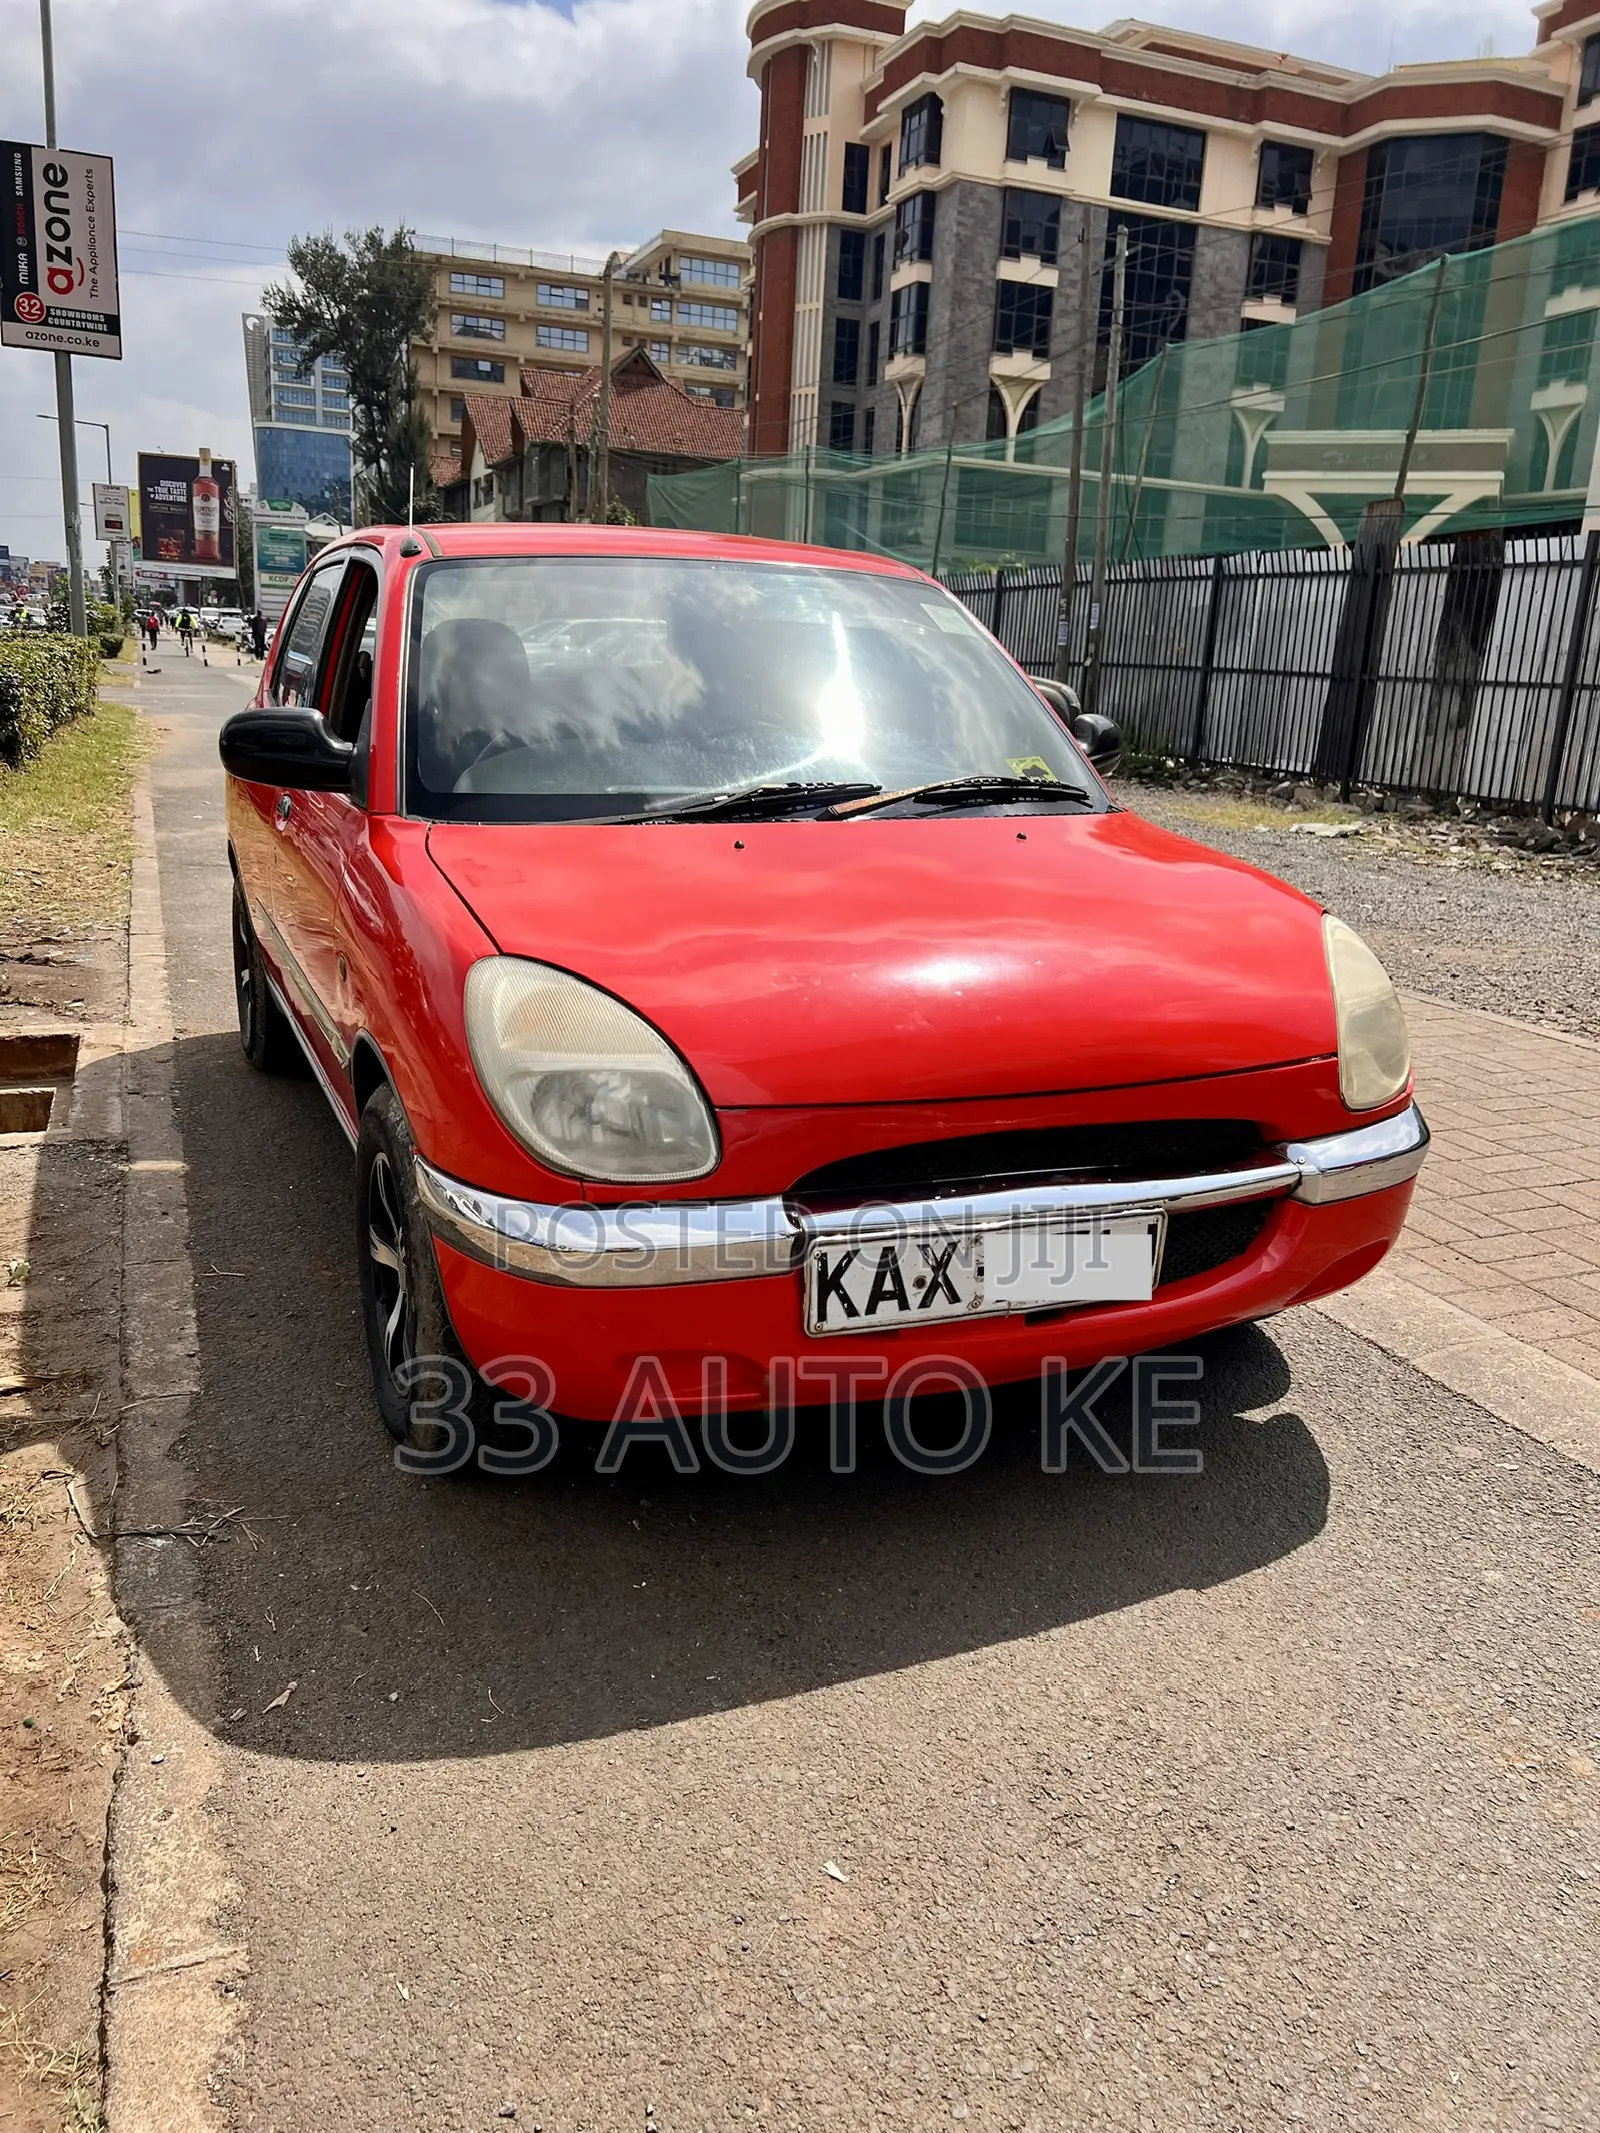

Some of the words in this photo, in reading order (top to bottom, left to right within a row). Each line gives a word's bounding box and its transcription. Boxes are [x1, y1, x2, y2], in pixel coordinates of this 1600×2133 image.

[14, 152, 23, 196] SAMSUNG
[85, 168, 96, 213] Experts
[16, 203, 26, 235] BOSCH
[43, 162, 74, 295] azone
[87, 215, 99, 273] Appliance
[90, 277, 98, 299] The
[19, 297, 41, 314] 32
[50, 308, 105, 322] SHOWROOMS
[48, 317, 108, 332] COUNTRYWIDE
[25, 329, 100, 348] azone.co.ke
[154, 486, 169, 494] TRUE
[170, 487, 187, 496] TASTE
[160, 480, 187, 489] DISCOVER
[154, 493, 187, 503] ADVENTURE
[268, 575, 289, 583] KCDF
[817, 1239, 963, 1322] KAX
